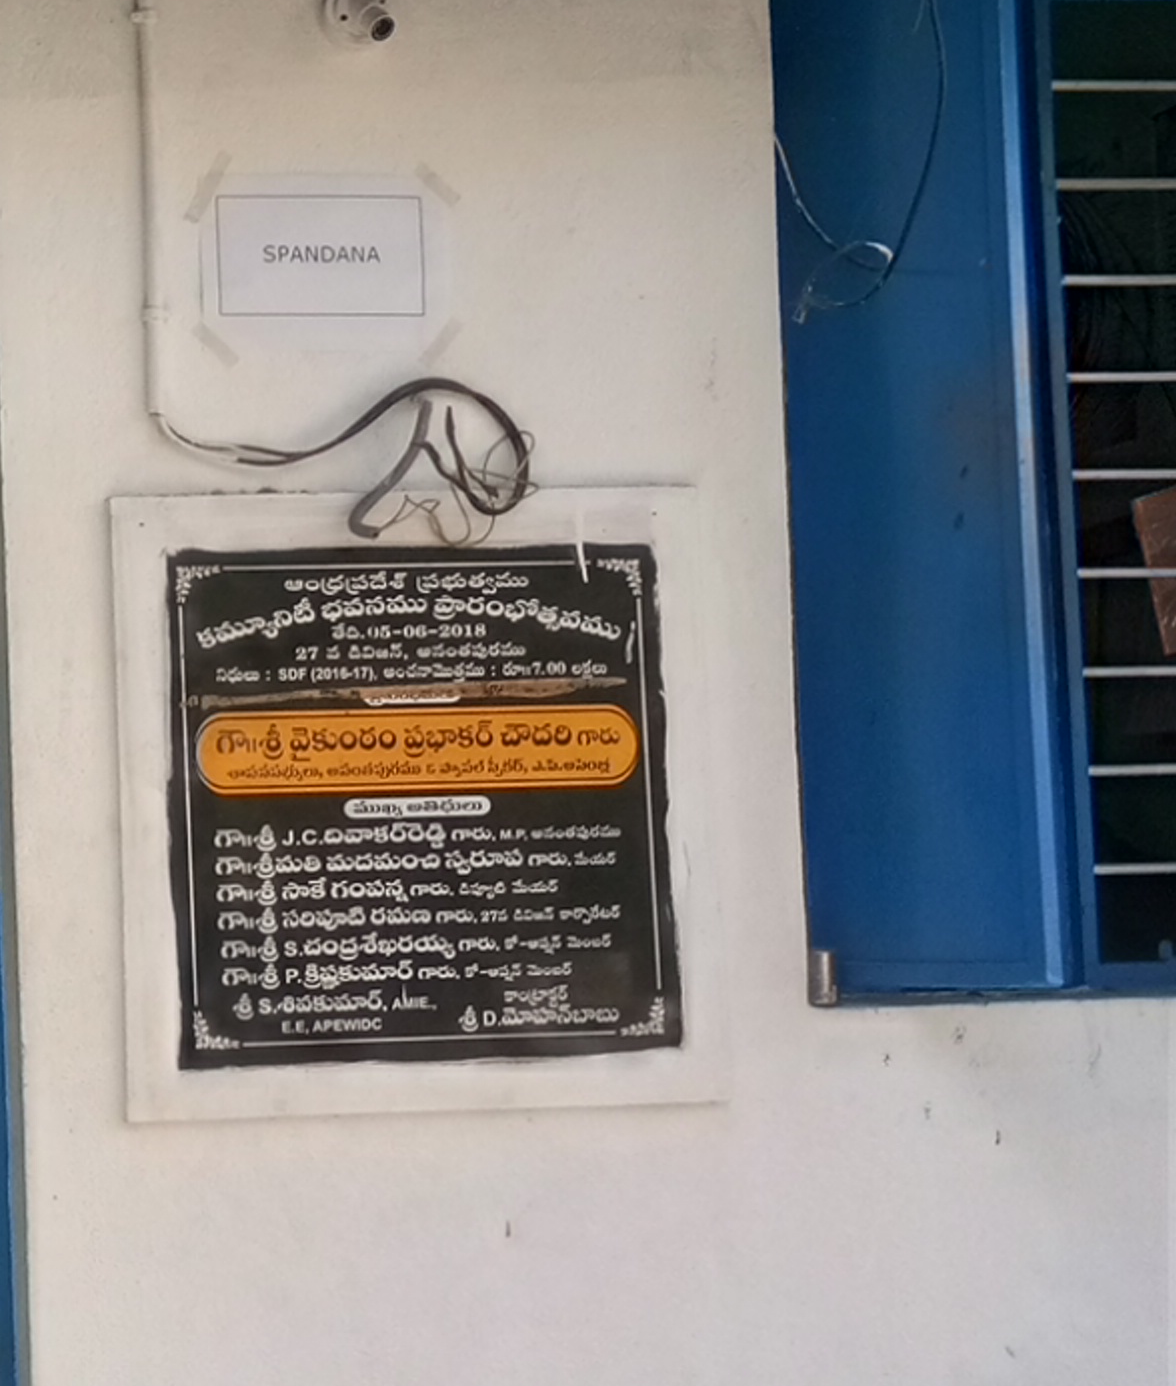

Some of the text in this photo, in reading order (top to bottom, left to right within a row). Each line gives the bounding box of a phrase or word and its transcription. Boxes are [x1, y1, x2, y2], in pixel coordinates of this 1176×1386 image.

[263, 244, 381, 263] SPANDANA
[284, 570, 408, 594] ఆంధ్రప్రదేశ్
[320, 594, 428, 622] భవనము
[295, 646, 318, 660] 27
[277, 667, 307, 681] SDF
[403, 720, 493, 758] ప్రభాకర్
[500, 723, 572, 747] చౌదరి
[577, 727, 620, 747] గారు
[232, 992, 254, 1020] శ్రీ
[458, 1005, 480, 1032] శ్రీ
